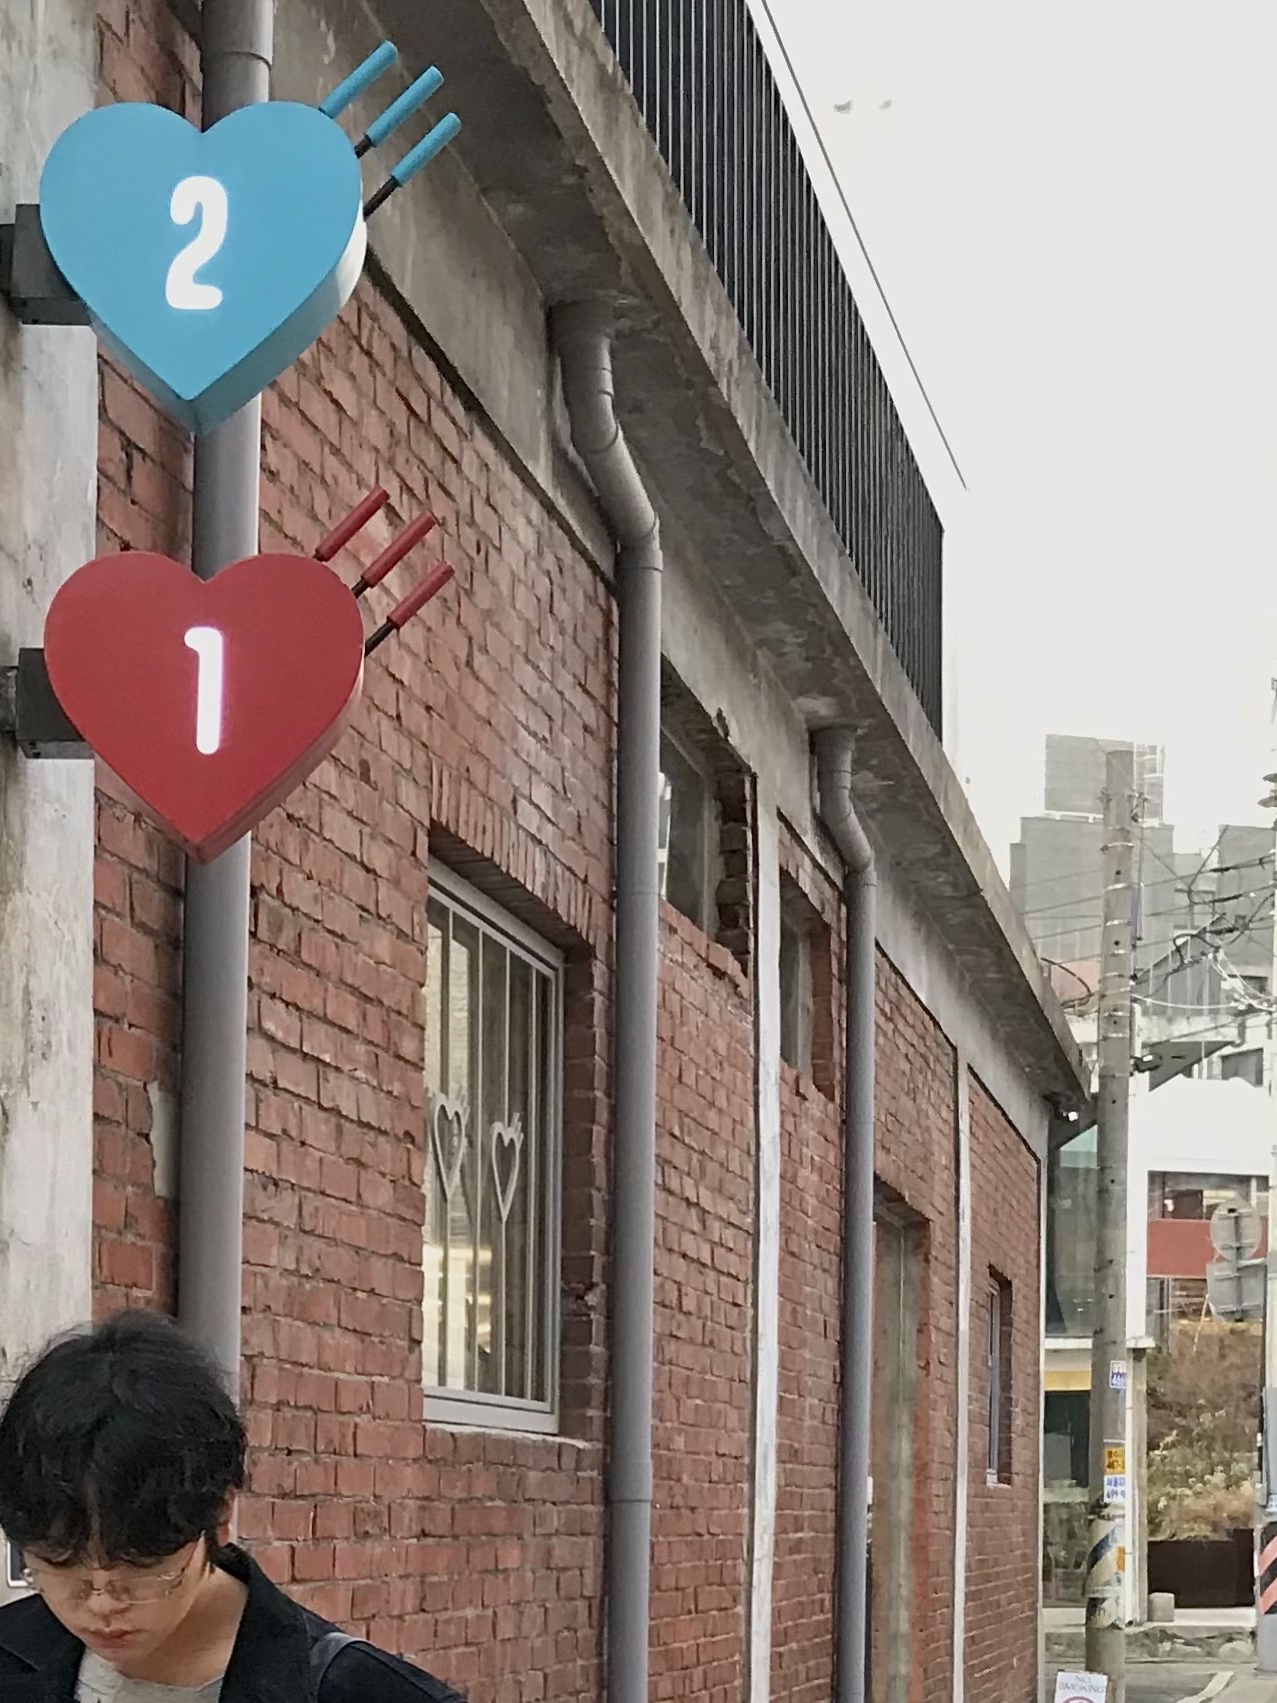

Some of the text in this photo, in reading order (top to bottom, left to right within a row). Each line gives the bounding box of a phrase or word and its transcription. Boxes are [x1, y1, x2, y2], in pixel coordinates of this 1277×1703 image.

[164, 175, 229, 311] 2
[184, 625, 225, 756] 1
[1058, 1681, 1105, 1694] SMOKING
[1075, 1674, 1092, 1683] NO
